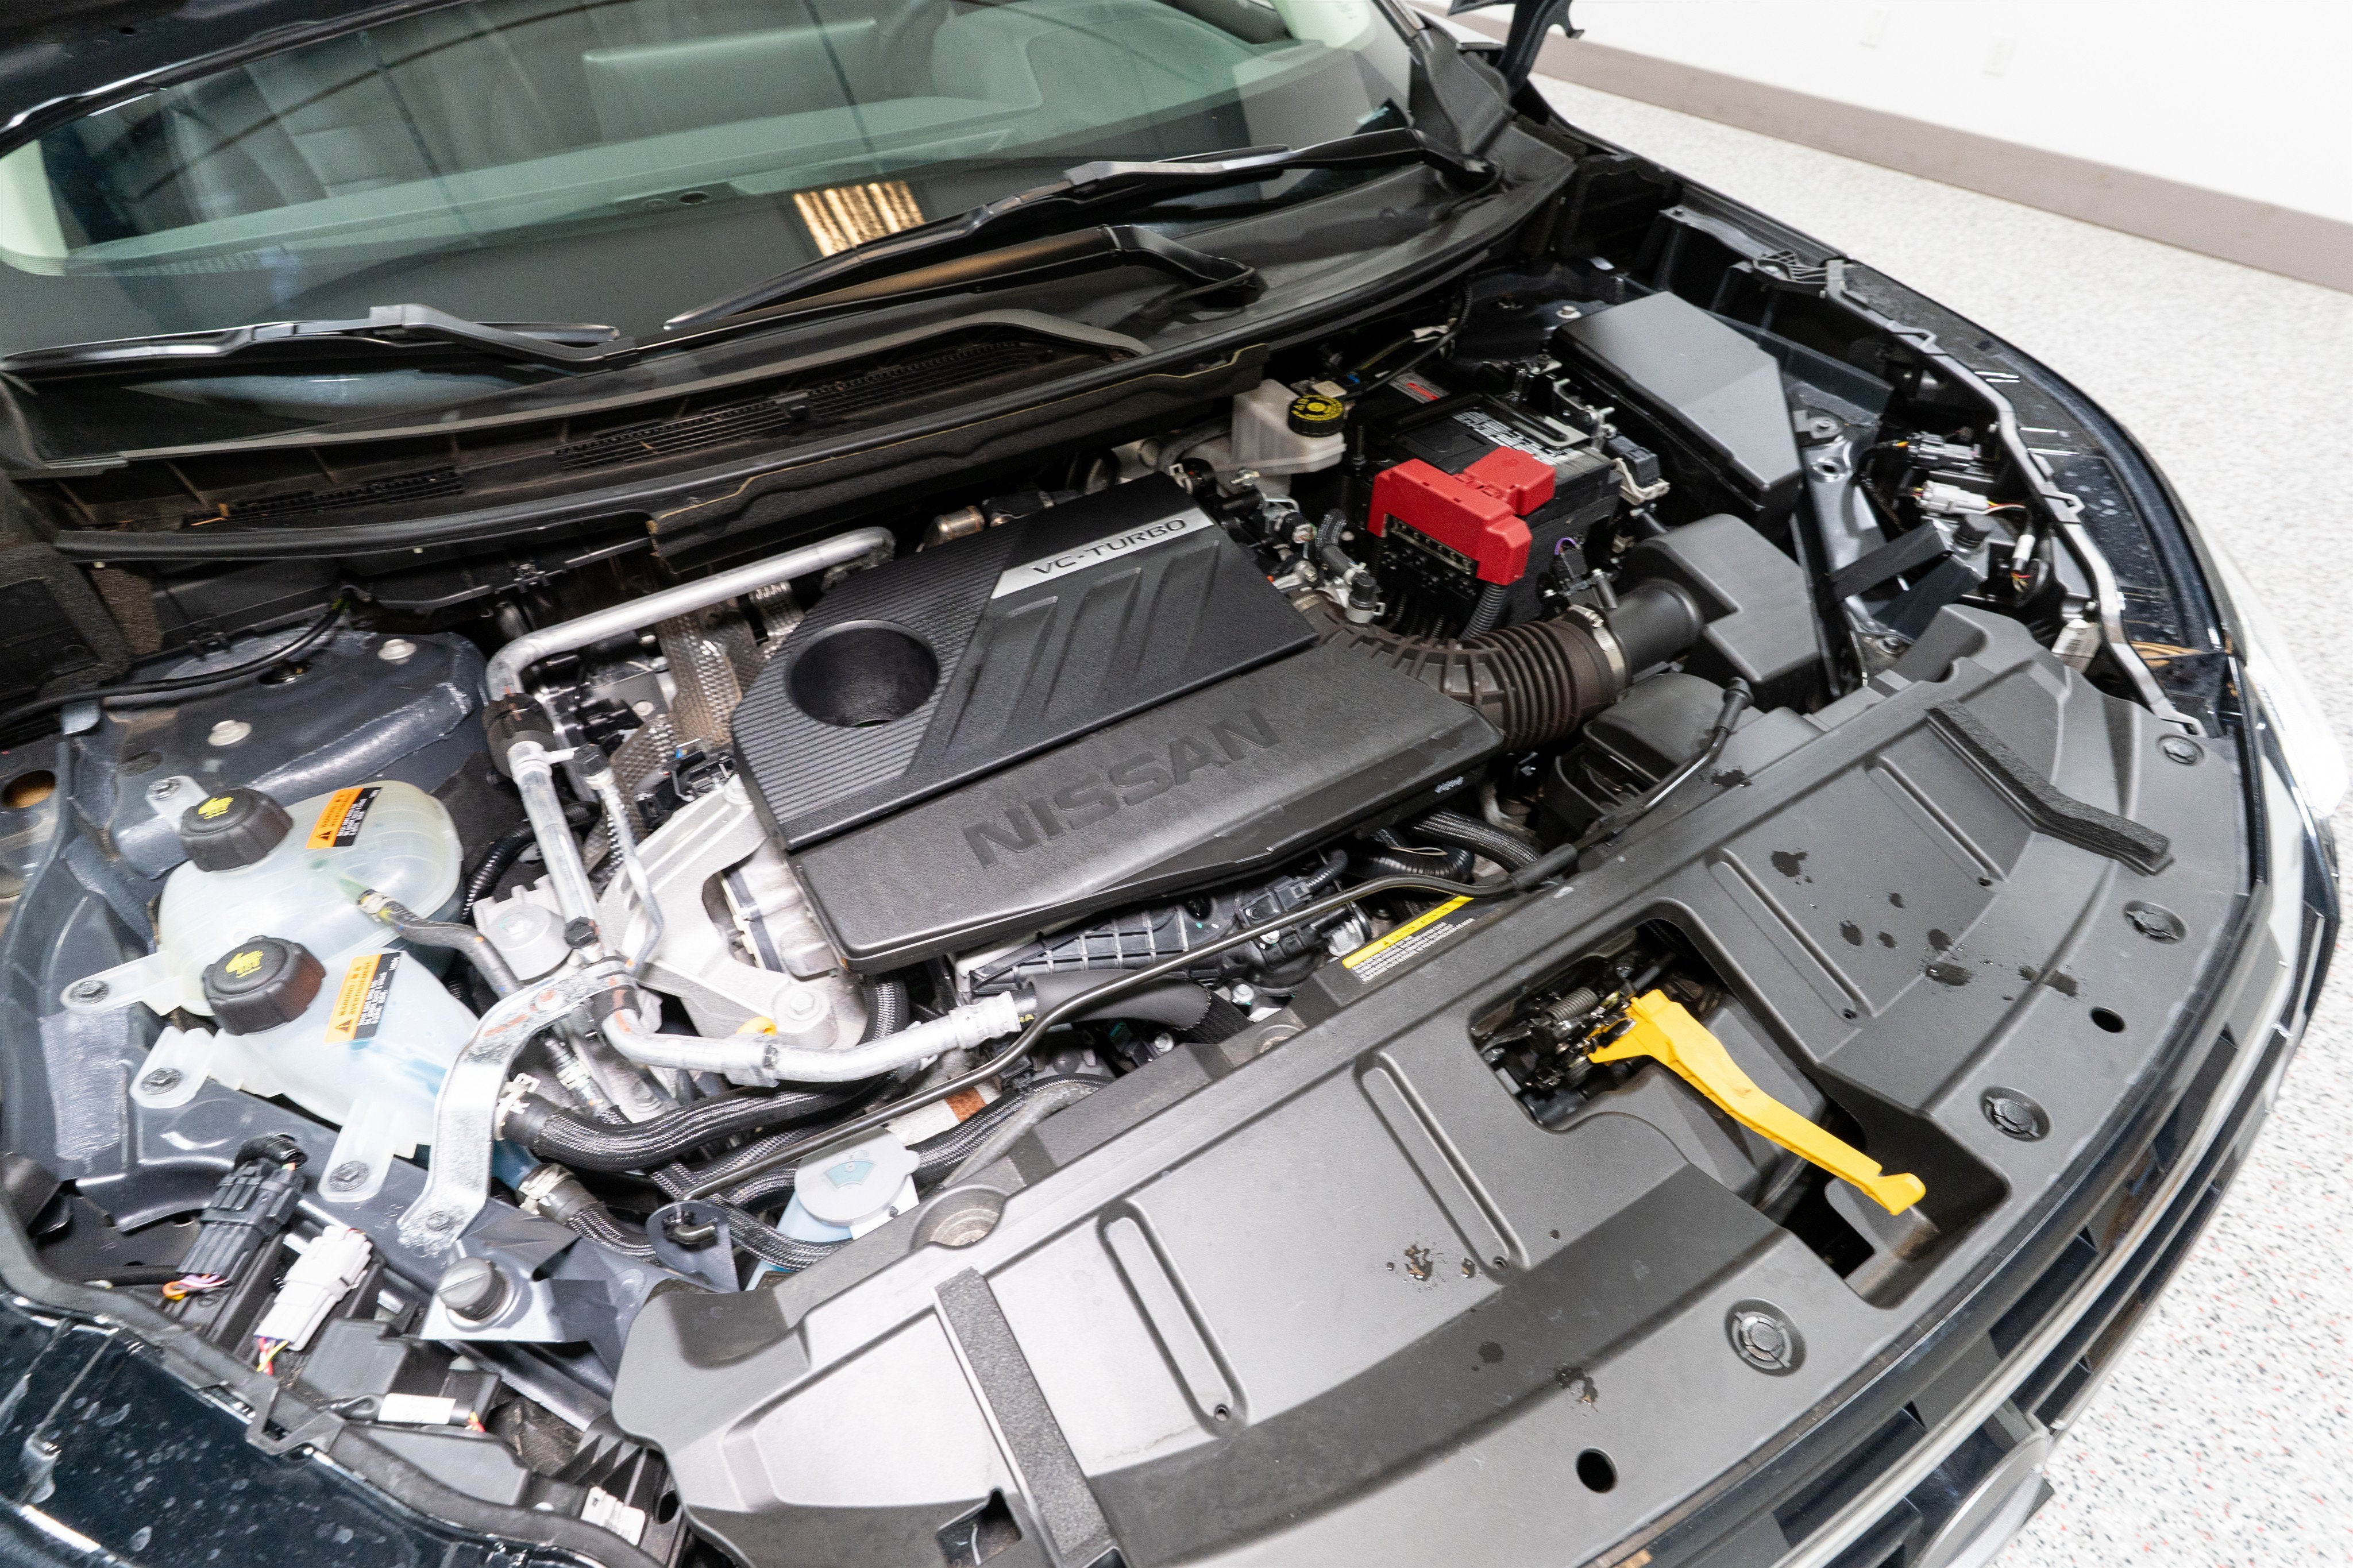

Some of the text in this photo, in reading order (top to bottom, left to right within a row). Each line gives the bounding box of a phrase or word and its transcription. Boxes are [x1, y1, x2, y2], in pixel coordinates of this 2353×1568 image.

[1029, 518, 1186, 574] VC-TURBO
[962, 708, 1283, 868] NISSAN
[338, 984, 355, 1016] WARNING
